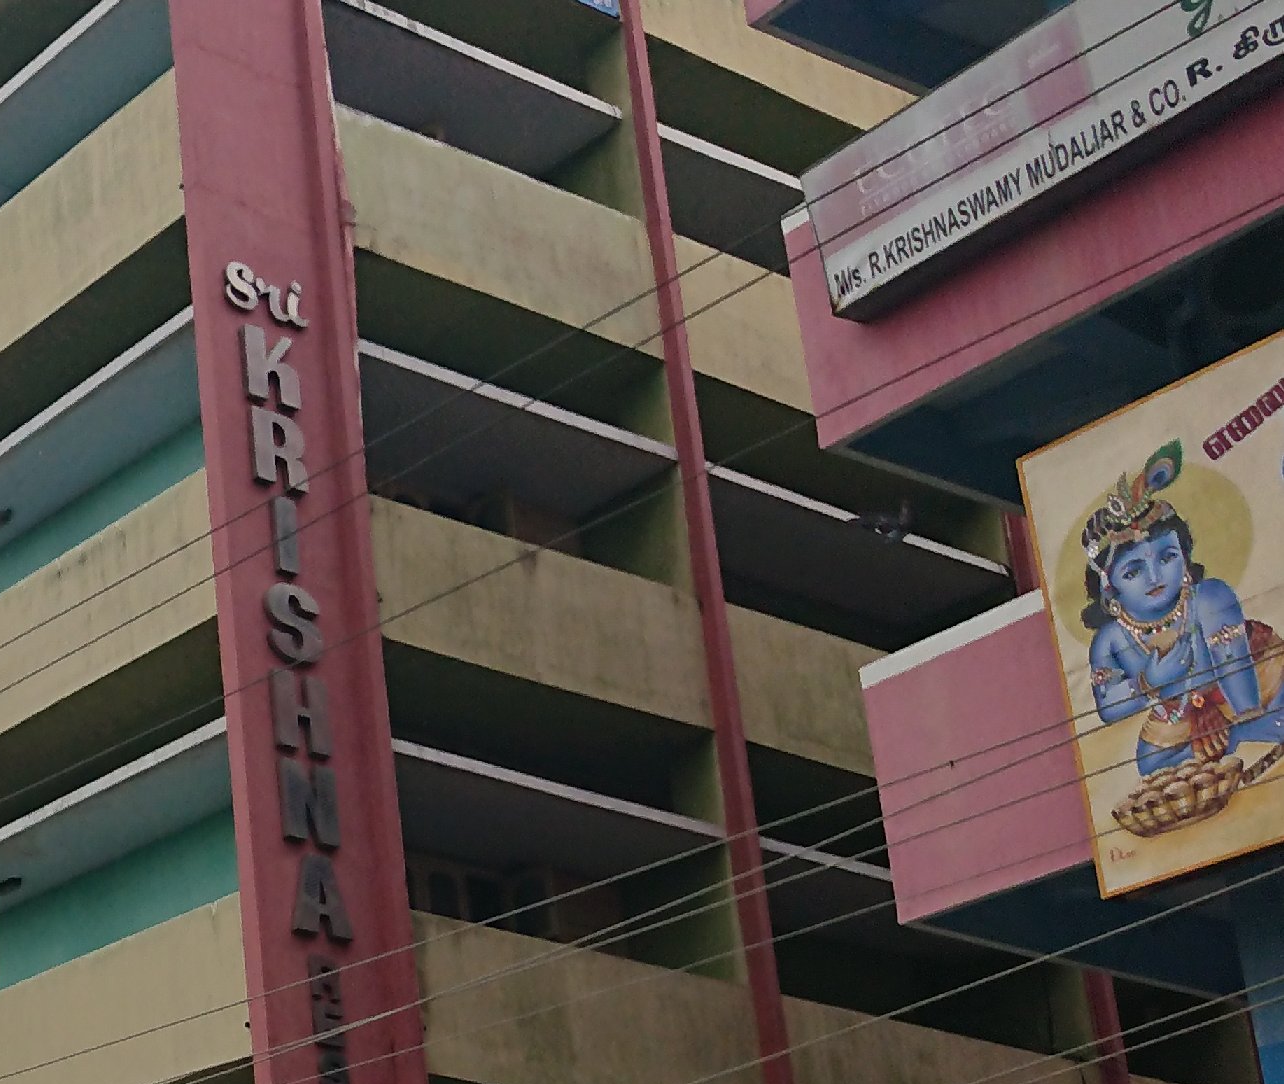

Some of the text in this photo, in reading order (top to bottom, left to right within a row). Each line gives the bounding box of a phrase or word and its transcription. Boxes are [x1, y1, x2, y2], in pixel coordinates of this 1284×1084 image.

[868, 167, 1023, 271] R.KRISHNASWAMY
[1027, 112, 1129, 189] MUDALIAR
[1131, 100, 1148, 127] &
[224, 260, 310, 330] Sri
[240, 323, 352, 943] KRISHNA
